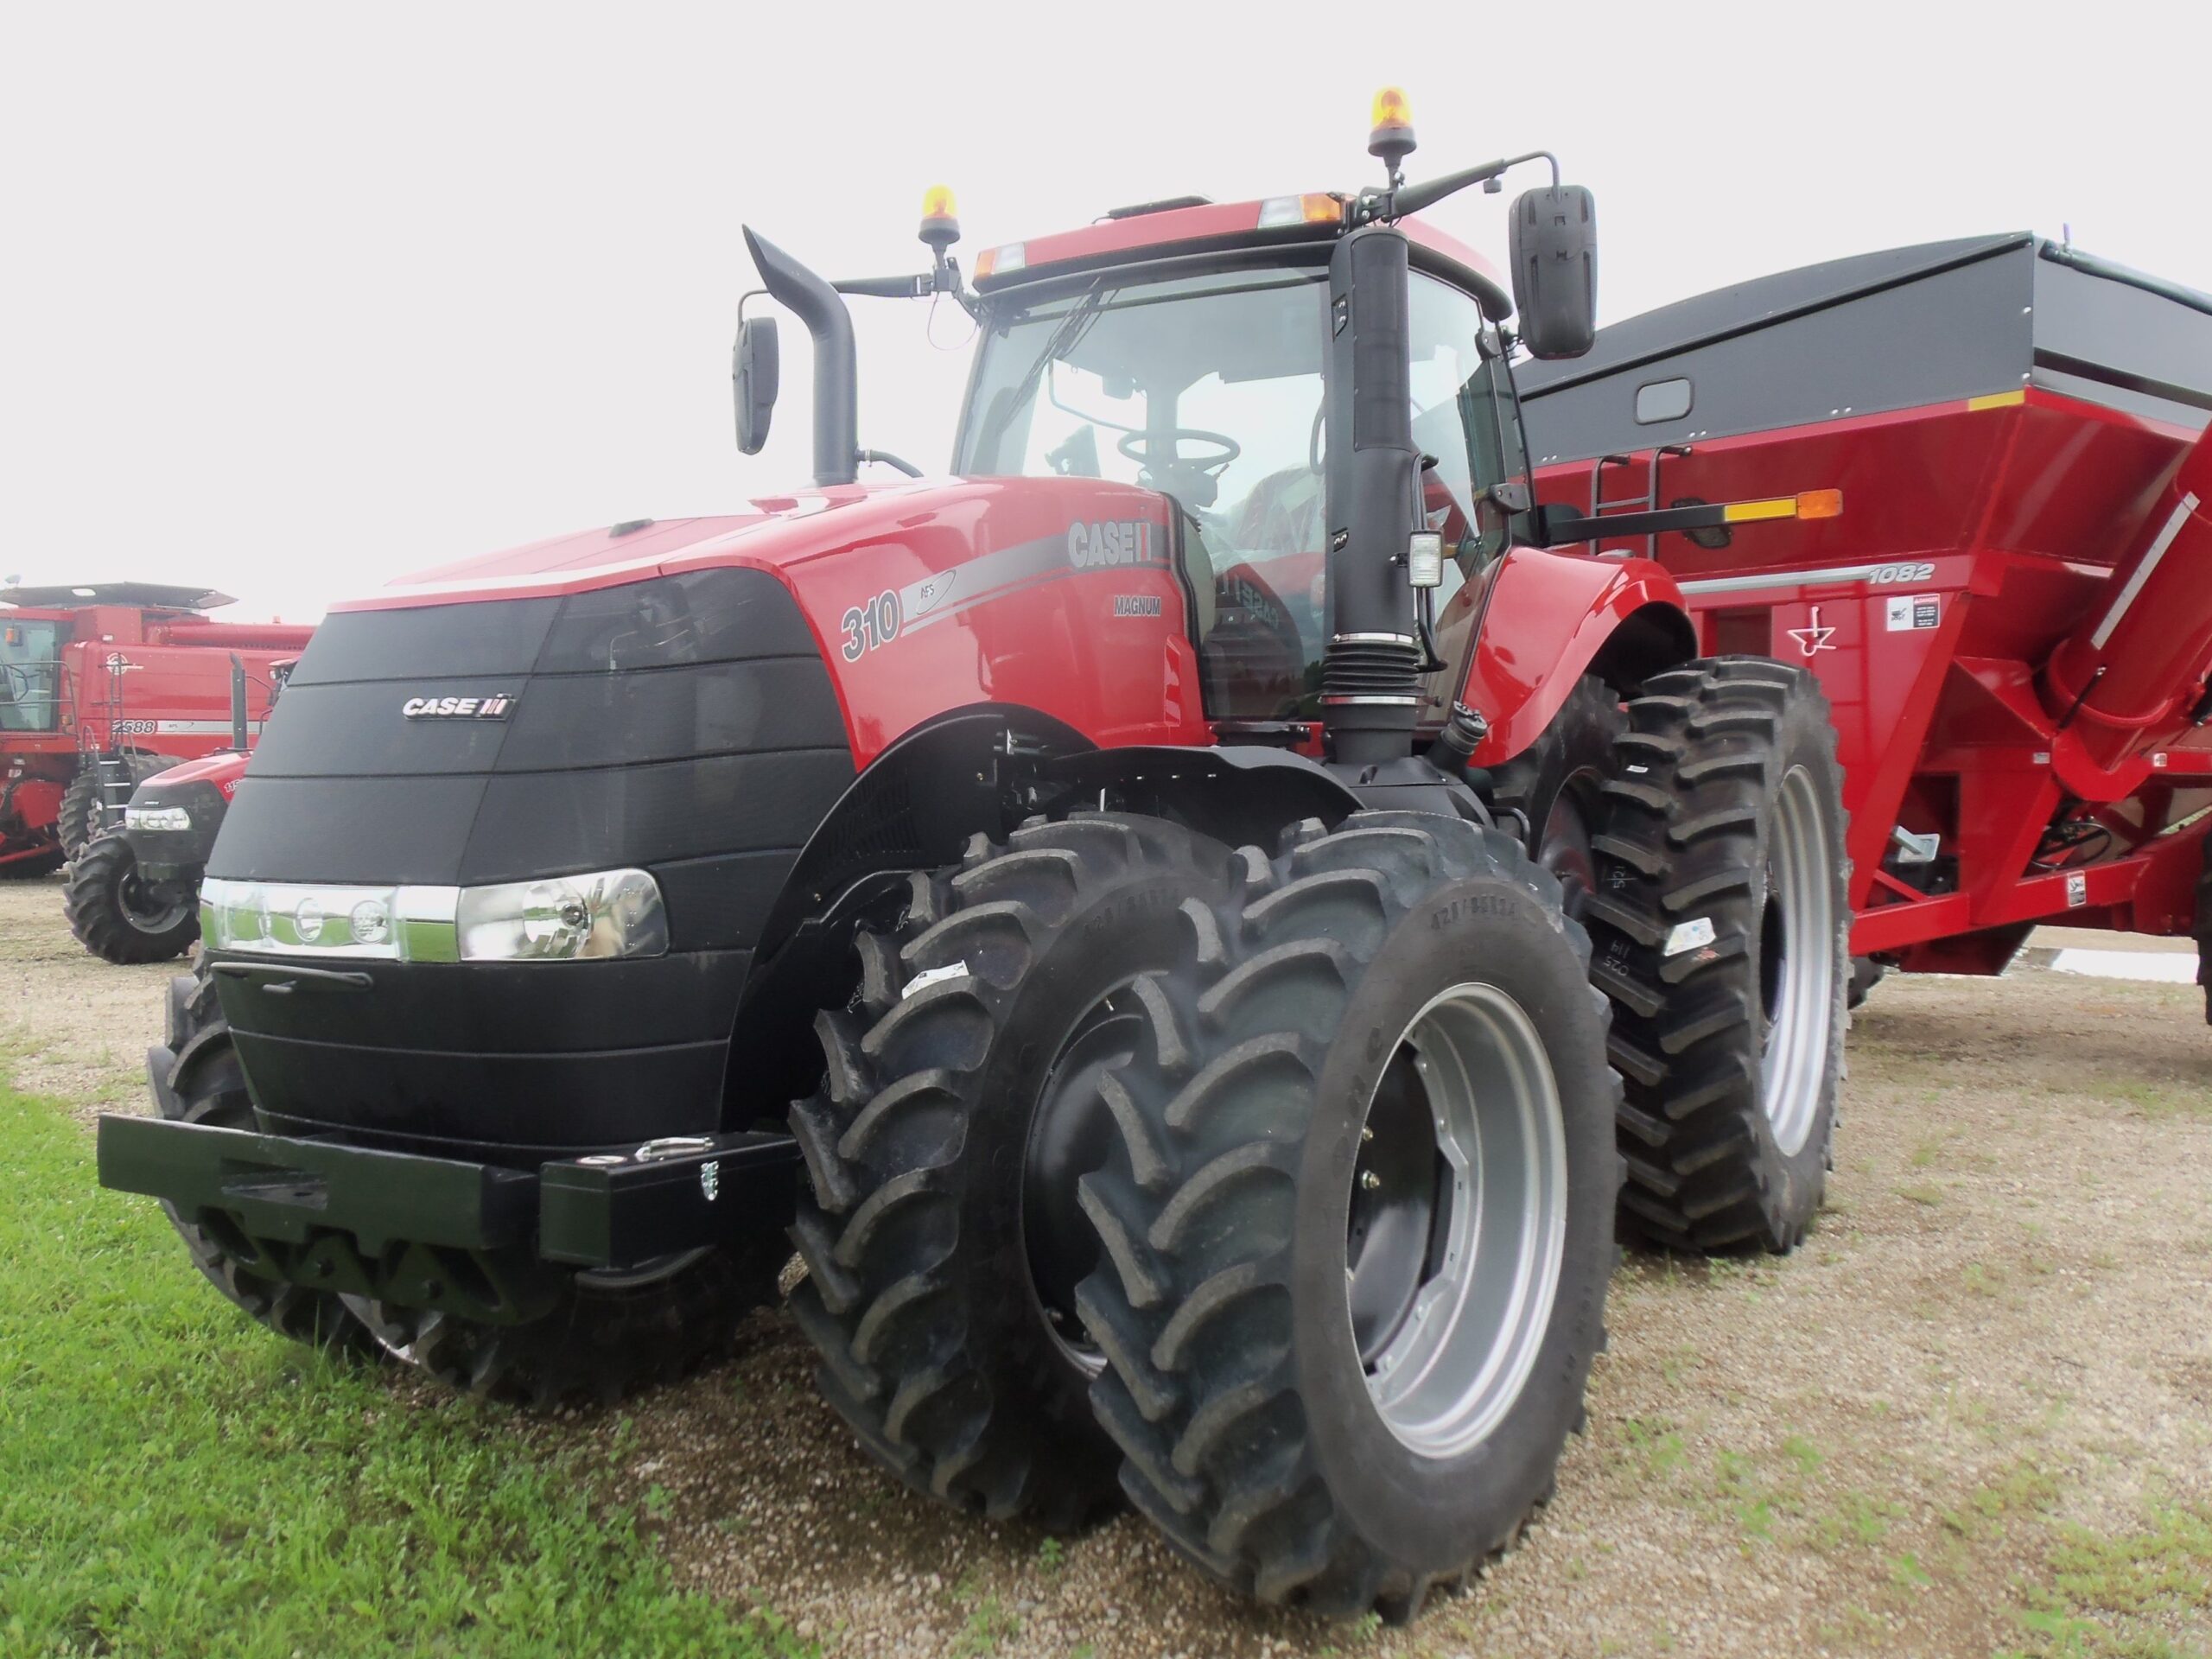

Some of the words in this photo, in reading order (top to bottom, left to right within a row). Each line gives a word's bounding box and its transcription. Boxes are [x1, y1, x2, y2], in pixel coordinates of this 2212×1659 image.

[1067, 521, 1134, 569] CASE
[1869, 563, 1936, 585] 1082
[1113, 594, 1161, 617] MAGNUM
[841, 588, 900, 664] 310
[402, 696, 480, 716] CASE
